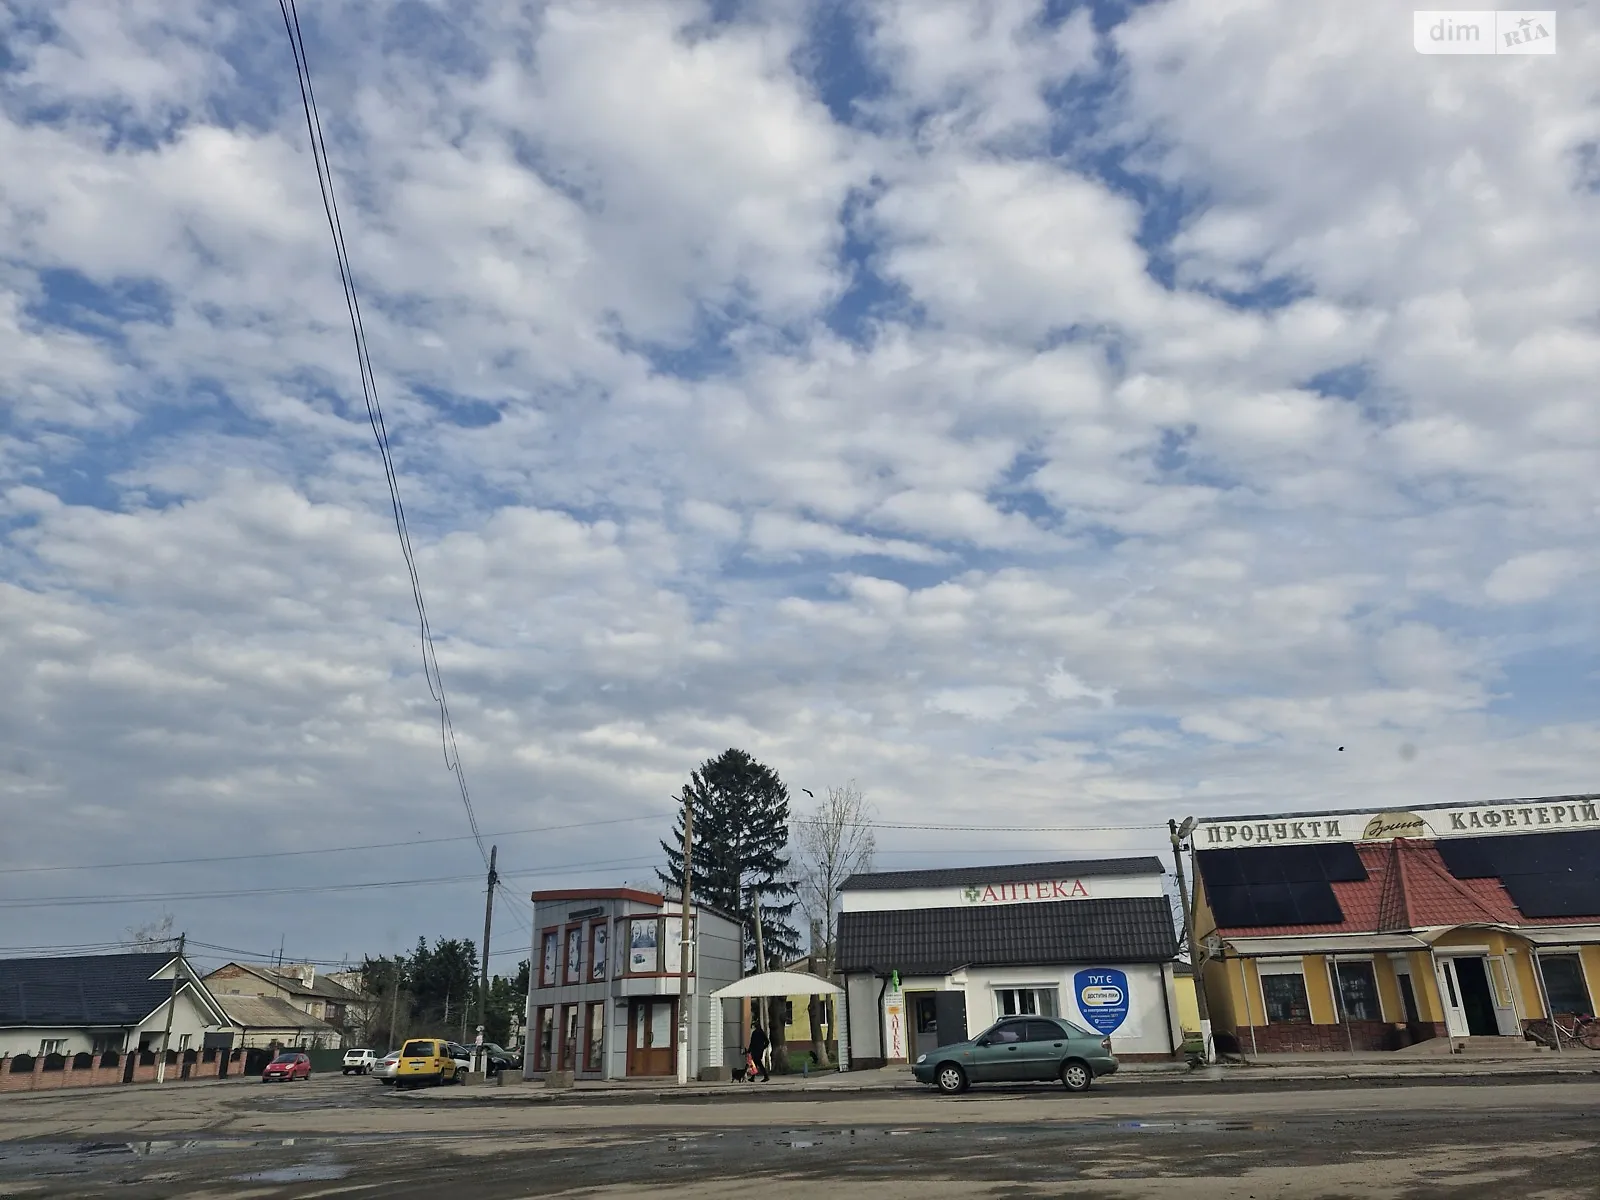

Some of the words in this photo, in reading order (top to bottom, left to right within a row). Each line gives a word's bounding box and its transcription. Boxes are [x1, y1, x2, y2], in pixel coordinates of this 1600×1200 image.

[1448, 800, 1599, 830] КАФЕТЕРІЙ
[1206, 820, 1342, 843] ПРОДУКТИ
[982, 879, 1089, 902] АПТЕКА
[1088, 975, 1104, 984] ТУТ
[1106, 975, 1113, 984] Є
[892, 1014, 901, 1058] АПТЕКА
